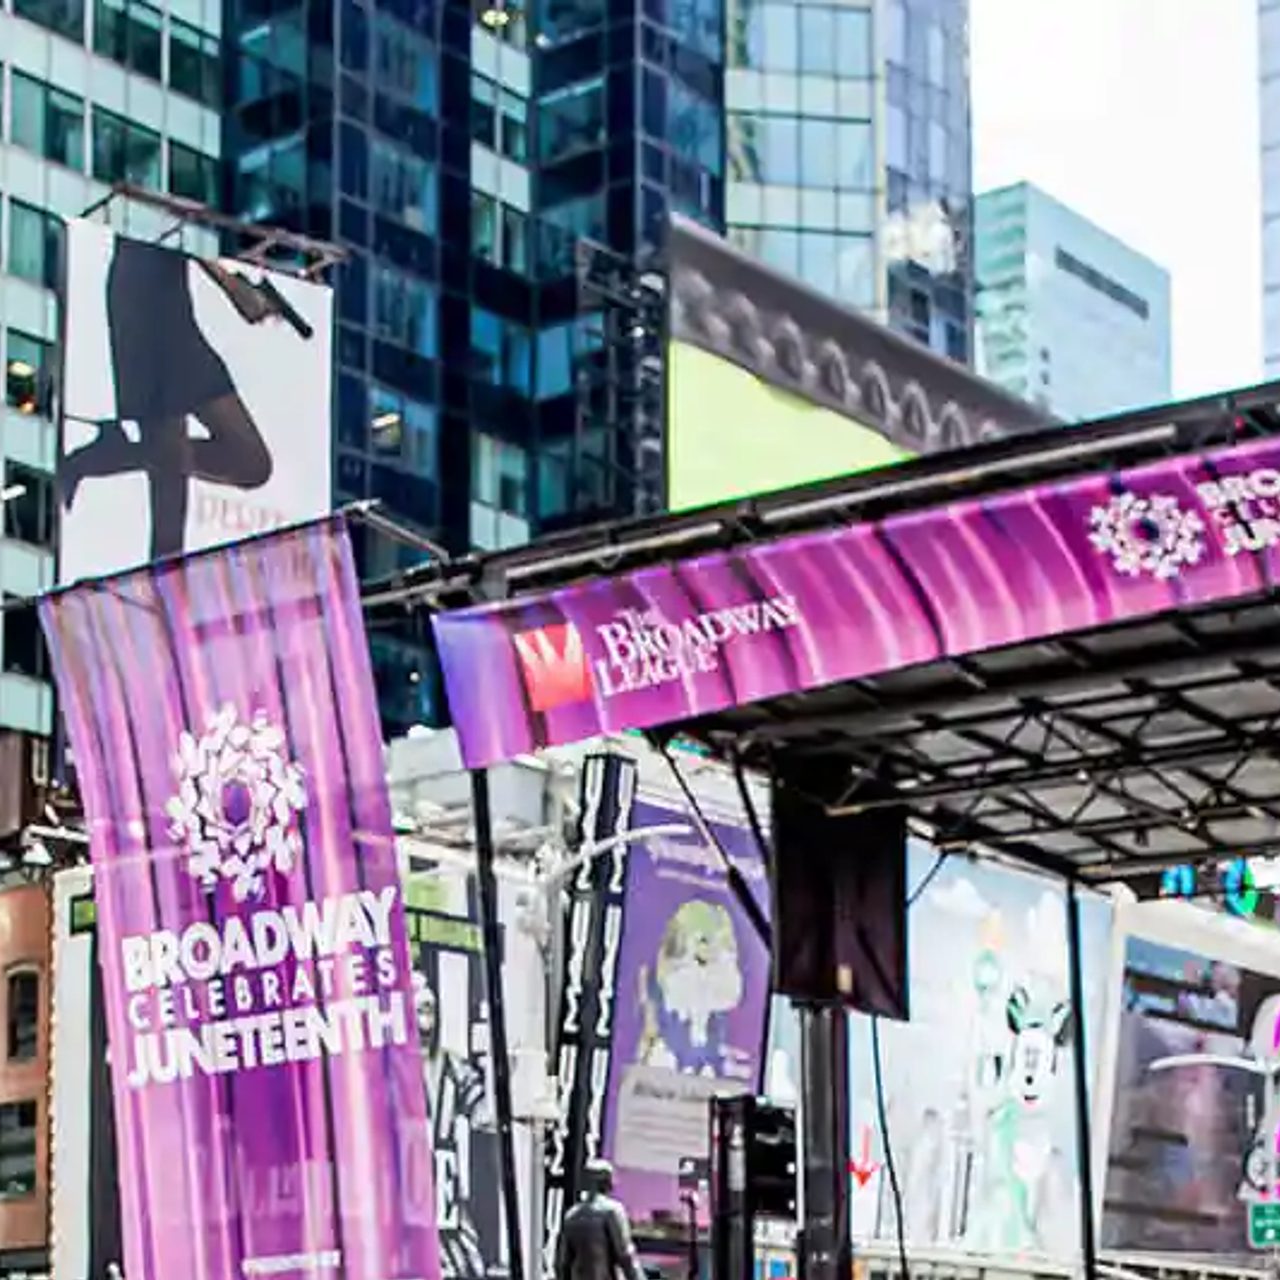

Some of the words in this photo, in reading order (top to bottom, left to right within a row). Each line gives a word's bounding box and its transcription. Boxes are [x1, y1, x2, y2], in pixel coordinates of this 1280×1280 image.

[596, 595, 800, 668] BROADWAY
[122, 886, 398, 992] BROADWAY
[128, 949, 398, 1030] CELEBRATES
[126, 990, 408, 1088] JUNETEENTH
